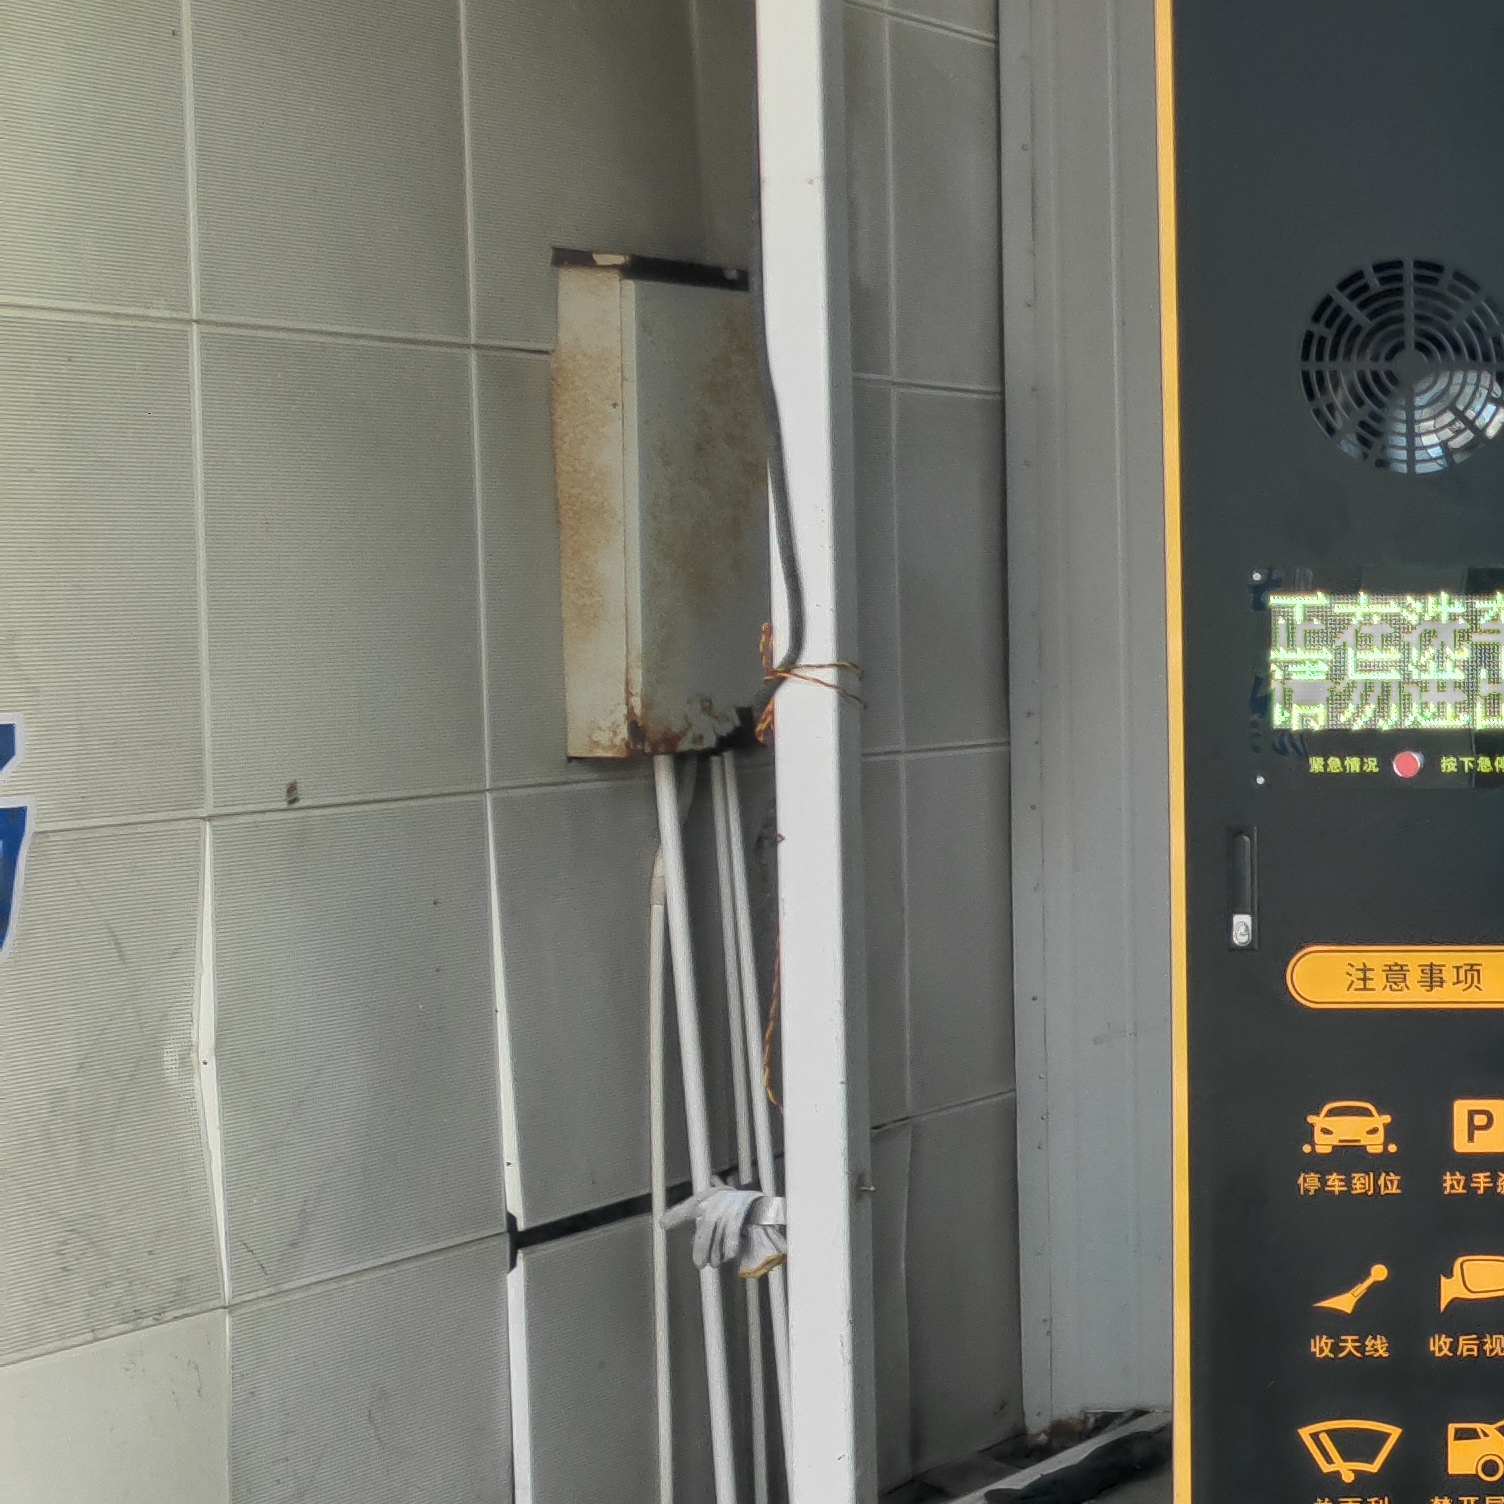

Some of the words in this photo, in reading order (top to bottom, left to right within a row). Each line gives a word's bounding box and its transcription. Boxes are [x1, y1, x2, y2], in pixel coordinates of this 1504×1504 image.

[1308, 756, 1380, 774] 紧急情况
[1345, 961, 1484, 993] 注意事项
[1466, 1108, 1495, 1144] P
[1297, 1171, 1402, 1196] 停车到位
[1309, 1334, 1391, 1359] 收天线
